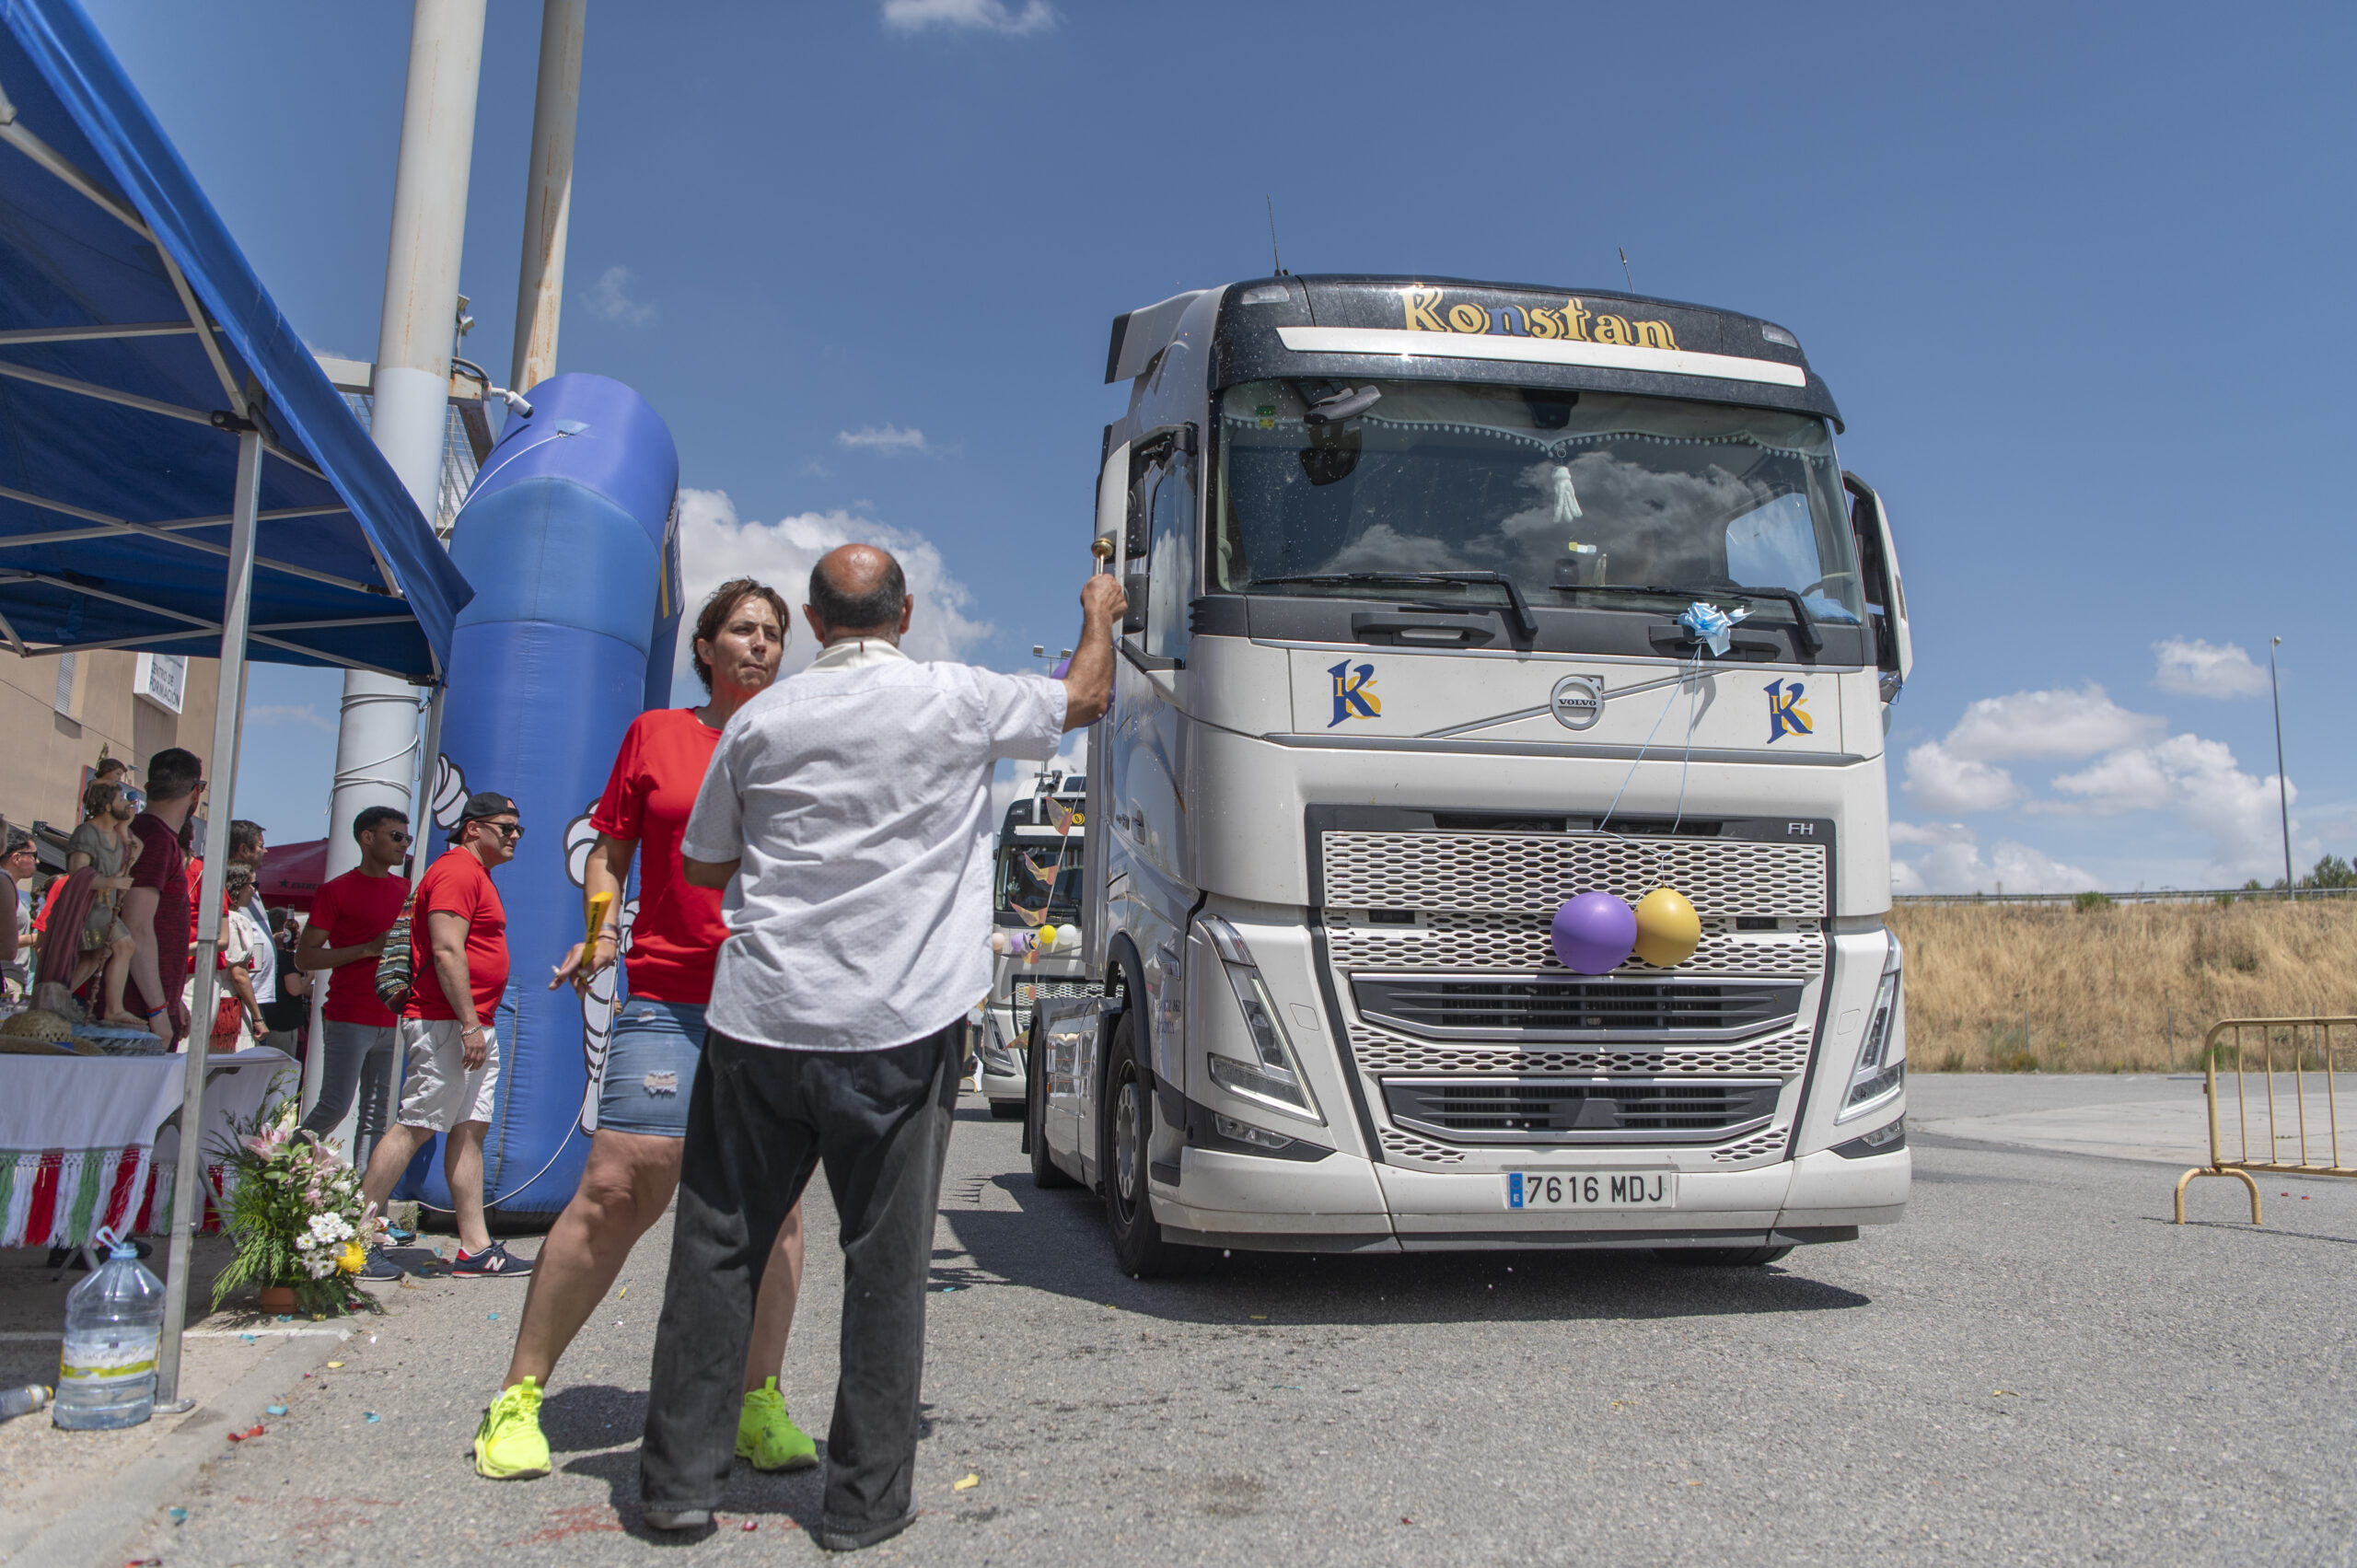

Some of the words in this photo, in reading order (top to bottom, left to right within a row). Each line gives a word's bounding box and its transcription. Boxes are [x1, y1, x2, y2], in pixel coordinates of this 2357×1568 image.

[1399, 283, 1680, 351] Konstan
[167, 672, 174, 687] DE
[1787, 822, 1814, 836] FH
[290, 881, 319, 890] ESTRE
[1527, 1176, 1599, 1203] 7616
[1610, 1175, 1663, 1203] MDJ
[1513, 1193, 1520, 1202] E
